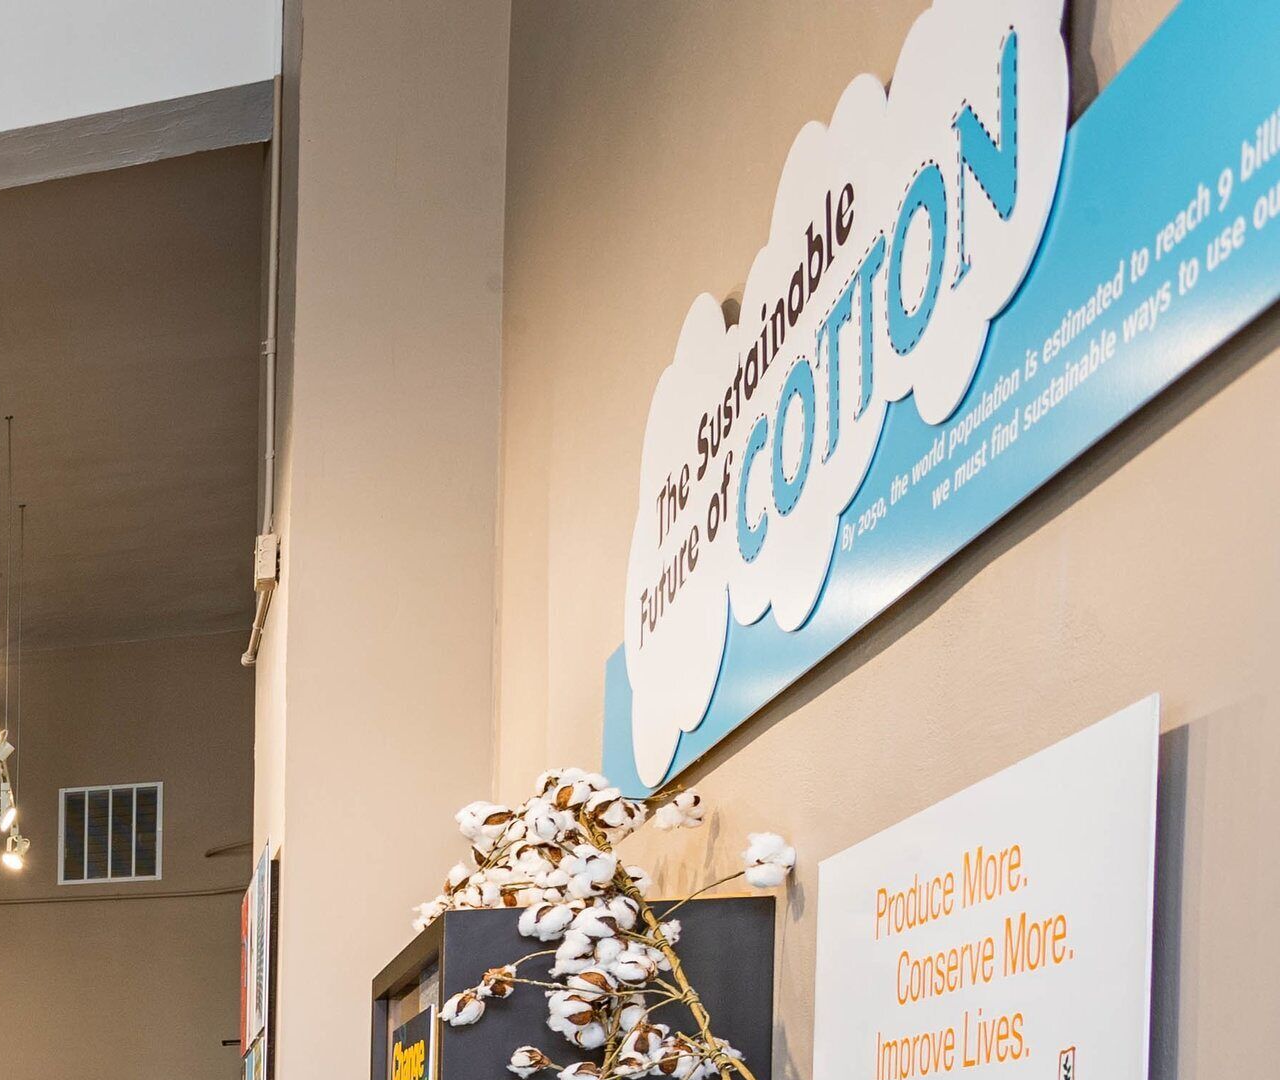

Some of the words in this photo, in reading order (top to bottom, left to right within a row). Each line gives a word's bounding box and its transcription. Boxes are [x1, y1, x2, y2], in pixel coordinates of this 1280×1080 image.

[654, 459, 690, 549] The
[696, 181, 855, 481] Sustainable
[735, 25, 1018, 562] COTTON
[842, 523, 854, 551] By
[858, 497, 887, 536] 2050,
[891, 476, 908, 505] the
[912, 431, 945, 485] world
[948, 368, 1019, 459] population
[1025, 350, 1038, 380] is
[1043, 260, 1124, 364] estimated
[1131, 247, 1149, 283] to
[1155, 182, 1210, 261] reach
[1218, 168, 1233, 212] 9
[932, 482, 950, 510] we
[954, 441, 987, 491] must
[991, 408, 1018, 459] find
[1023, 330, 1116, 431] sustainable
[1123, 281, 1171, 343] ways
[1178, 257, 1199, 296] to
[1206, 216, 1245, 271] use
[639, 520, 699, 650] Future
[707, 449, 735, 542] of
[875, 871, 955, 940] Produce
[962, 844, 1028, 910] More.
[896, 934, 995, 1006] Conserve
[1003, 912, 1074, 977] More.
[963, 1008, 1029, 1068] Lives.
